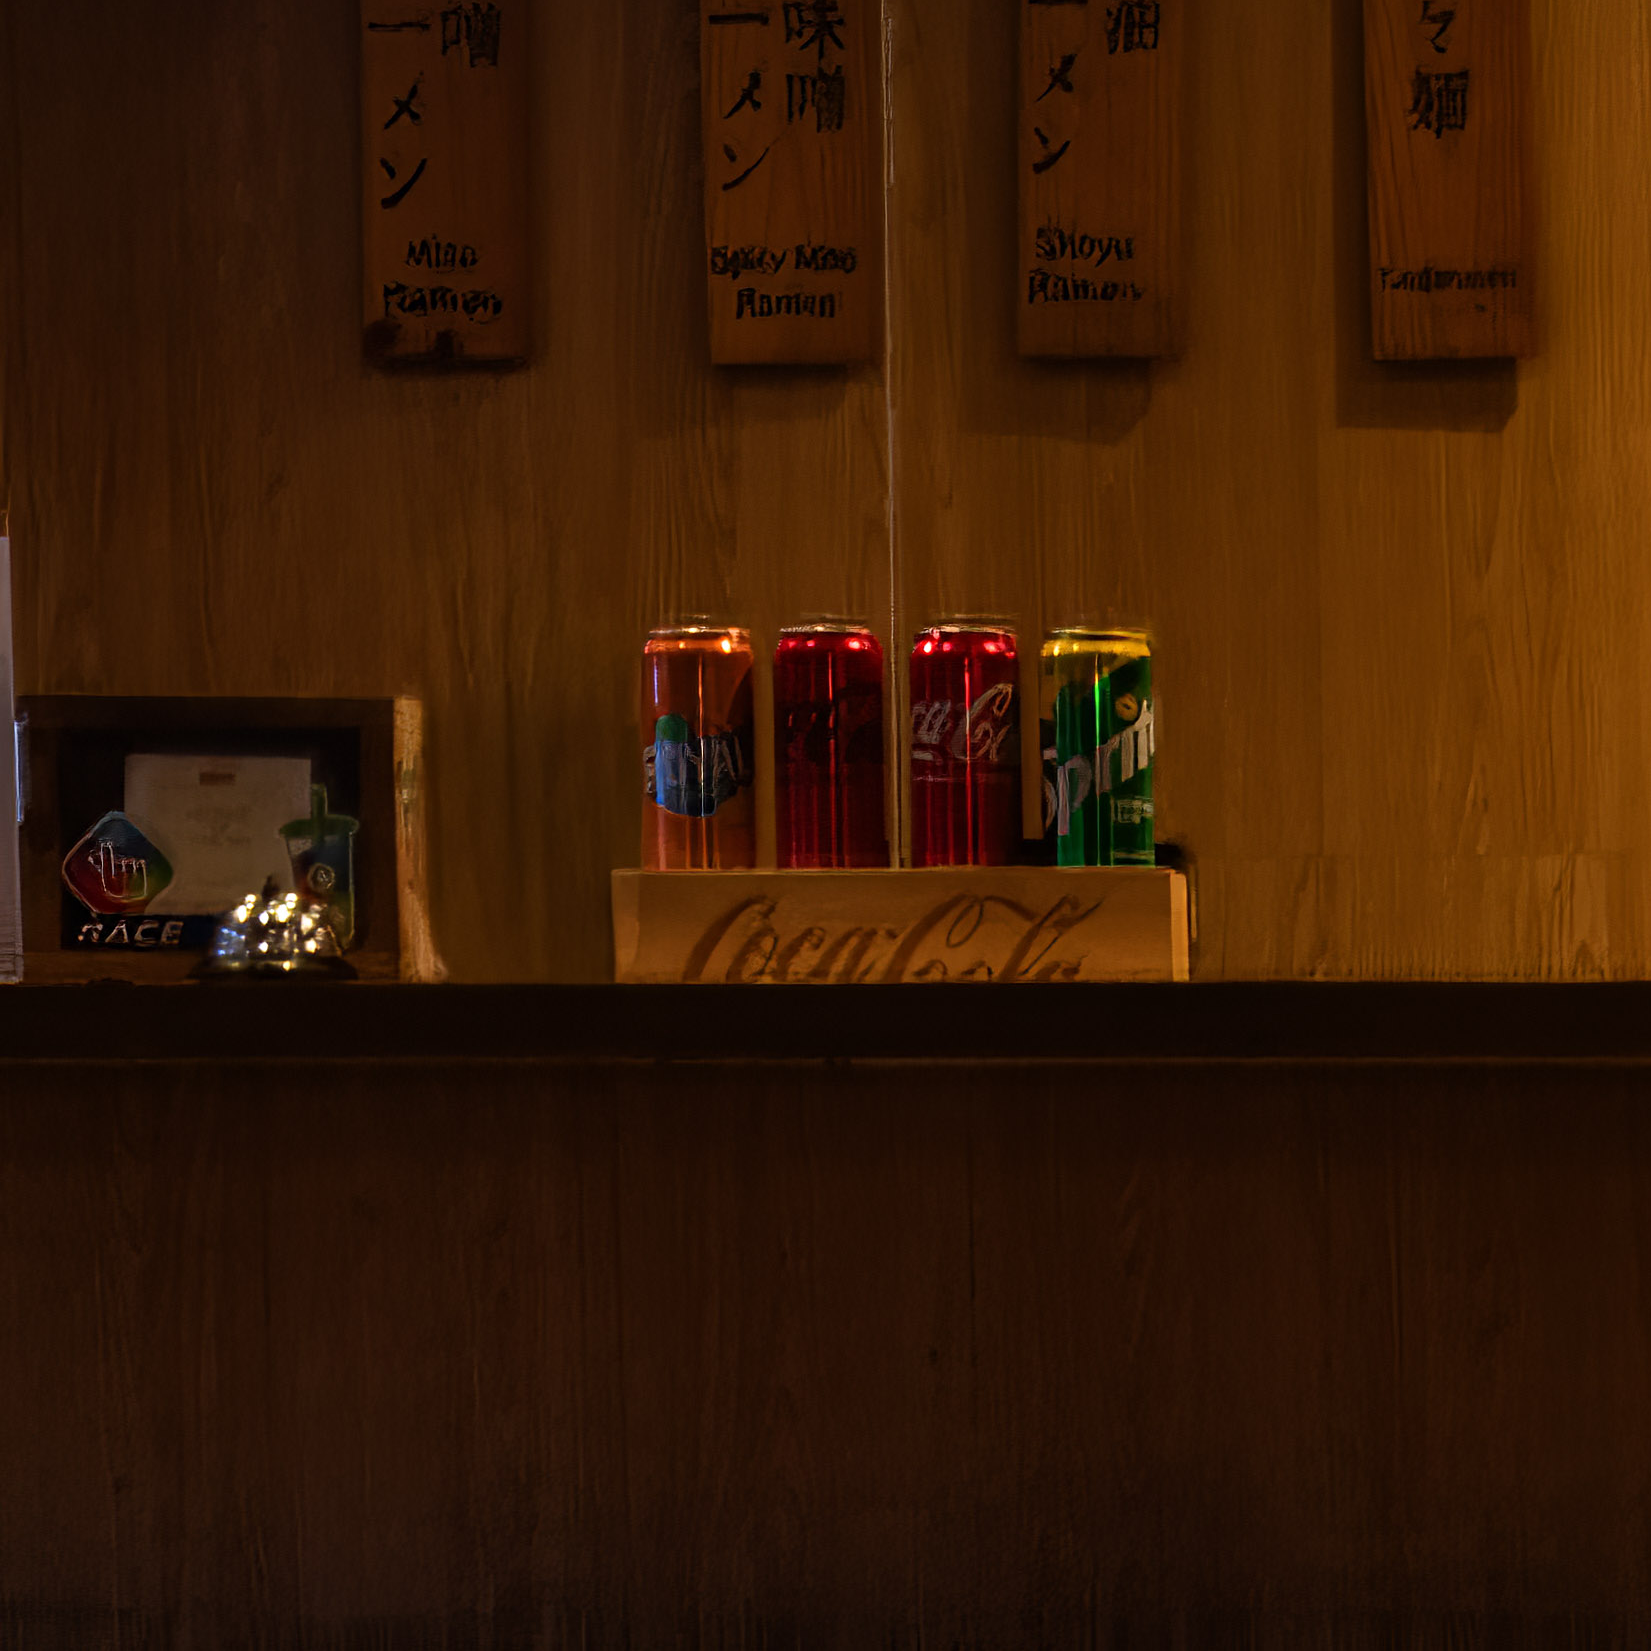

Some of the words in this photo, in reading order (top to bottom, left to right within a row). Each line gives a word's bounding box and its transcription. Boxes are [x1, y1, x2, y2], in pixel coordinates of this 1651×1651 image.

[383, 282, 503, 321] Ramen
[736, 286, 836, 319] Ramen
[1029, 269, 1143, 303] Ramen
